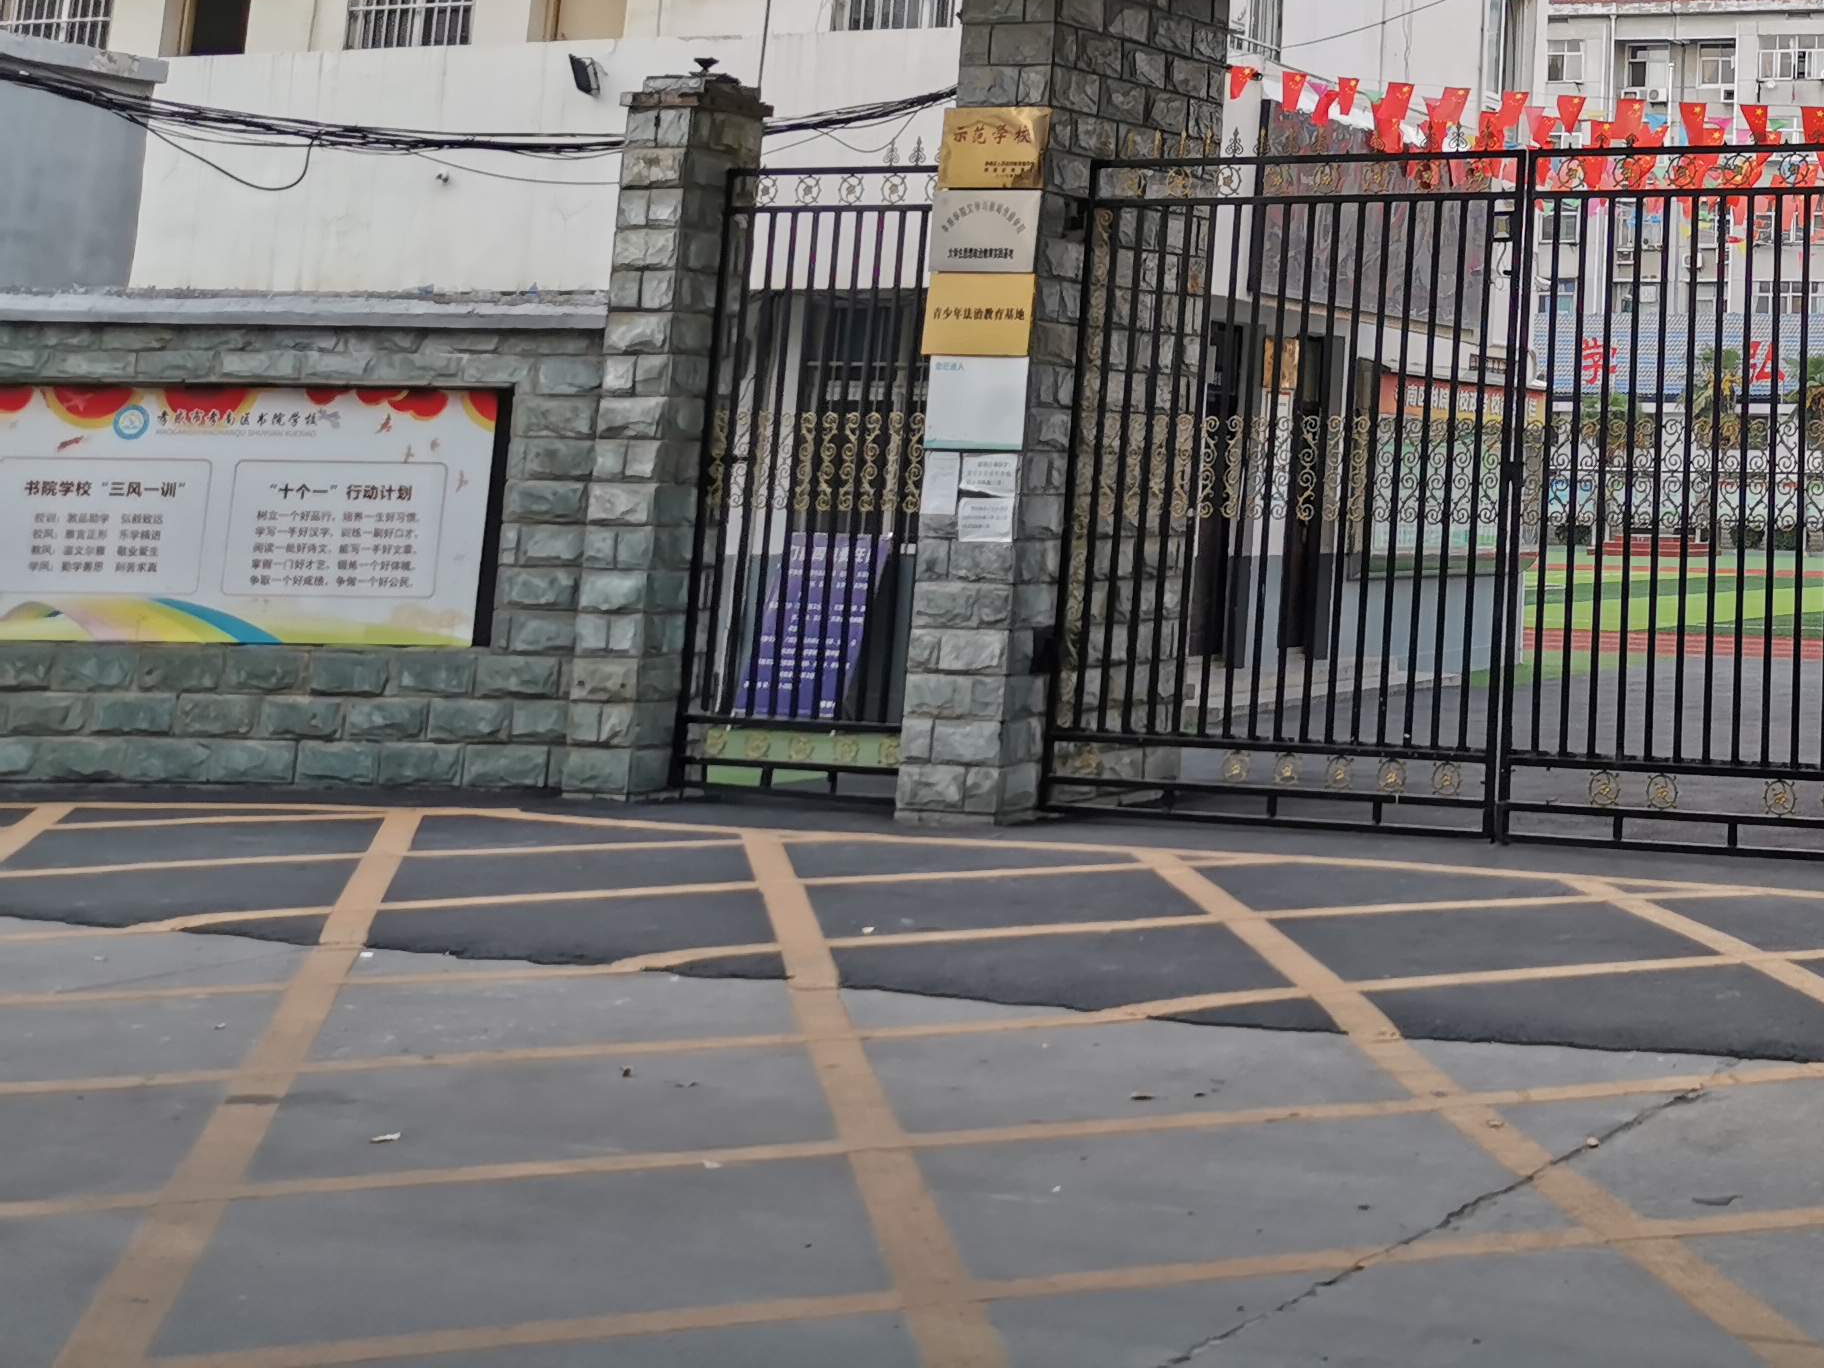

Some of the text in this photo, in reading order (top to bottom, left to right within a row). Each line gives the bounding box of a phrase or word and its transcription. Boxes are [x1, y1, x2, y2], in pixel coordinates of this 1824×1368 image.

[953, 124, 1032, 145] 示范学校
[932, 306, 1025, 322] 青少年法治教育基地
[156, 409, 318, 427] 孝感市孝南区书院学校
